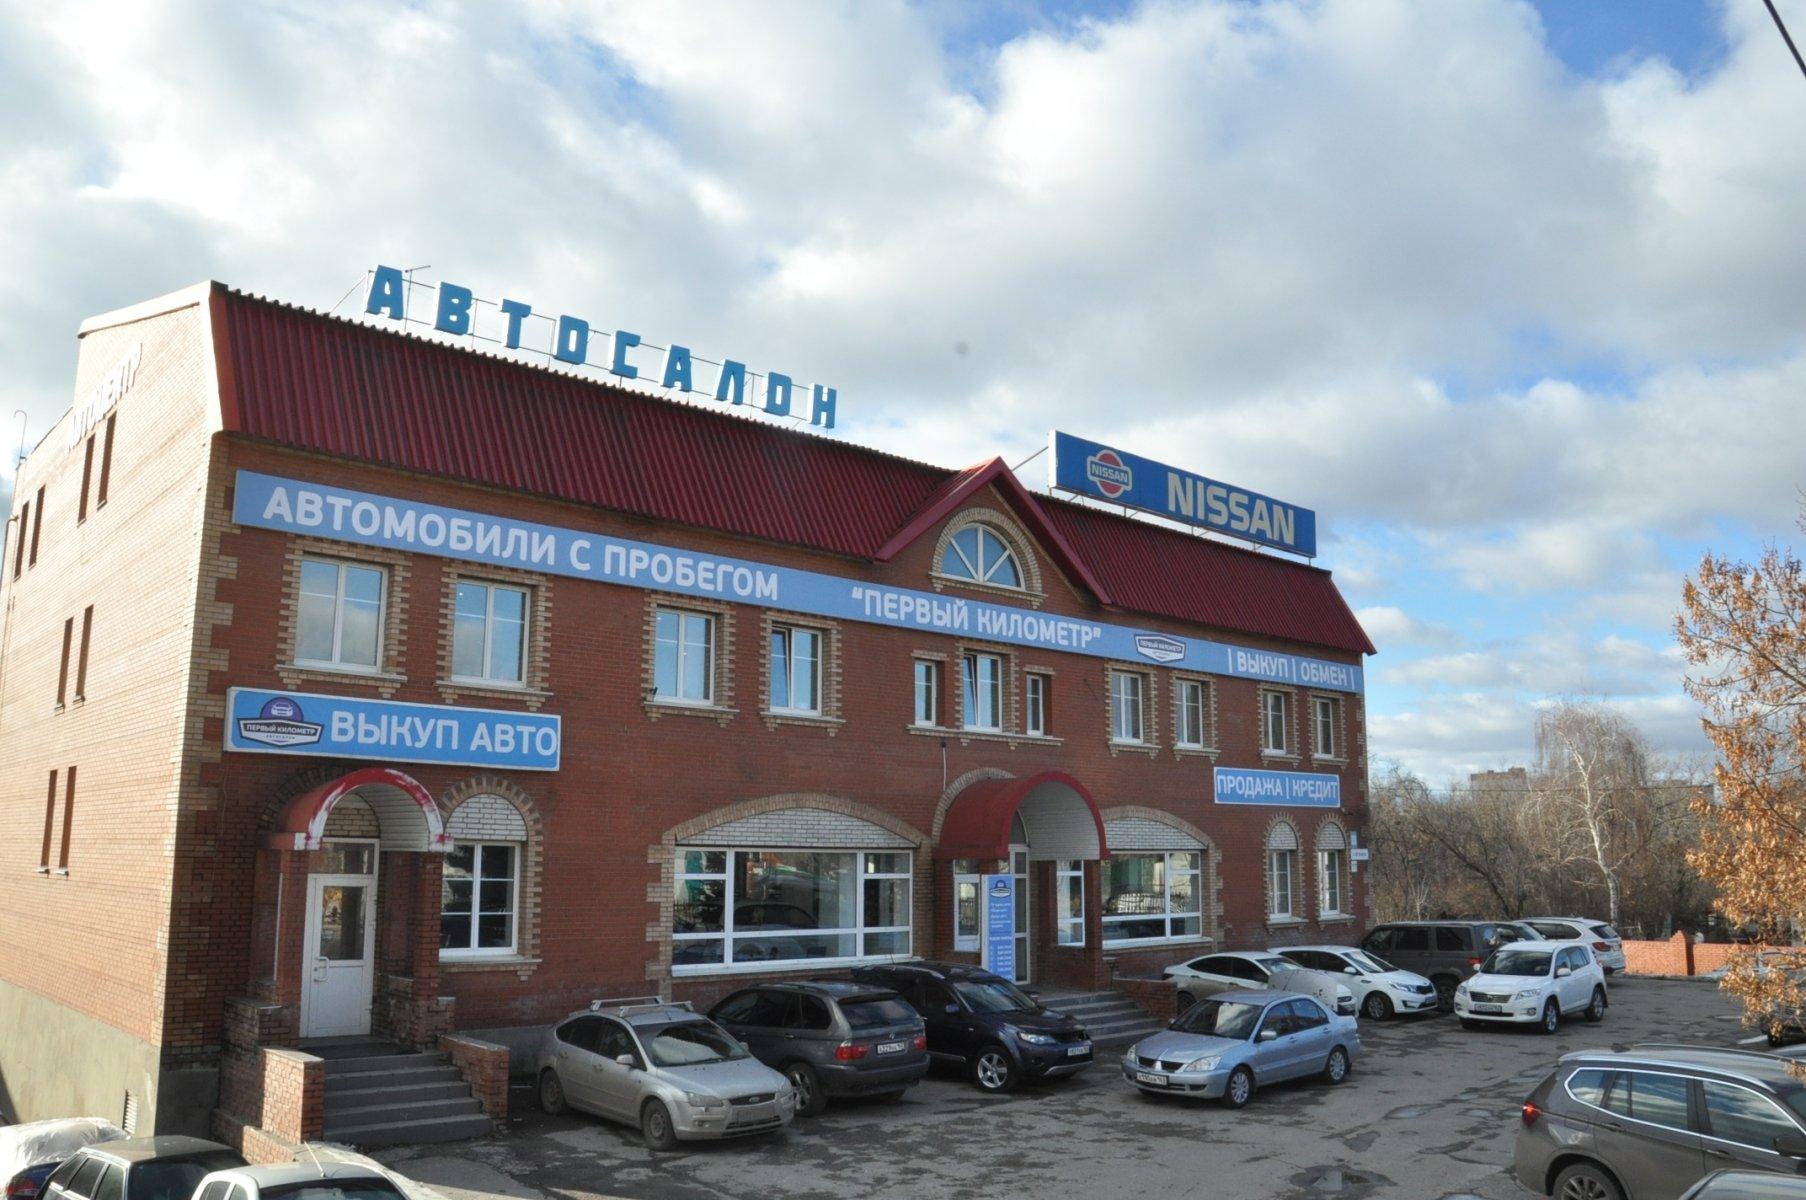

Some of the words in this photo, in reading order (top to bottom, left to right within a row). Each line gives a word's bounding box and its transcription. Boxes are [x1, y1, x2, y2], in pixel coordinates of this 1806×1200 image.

[366, 264, 838, 429] АВТОСАЛОН
[1091, 463, 1128, 483] NISSAN
[1168, 472, 1295, 545] NISSAN
[262, 486, 556, 566] АВТОМОБИЛИ
[569, 541, 592, 571] С
[604, 545, 779, 600] ПРОБЕГОМ
[1238, 654, 1288, 679] ВЫКУП
[1300, 664, 1346, 685] ОБМЕН
[247, 724, 276, 732] ПЕРВЫЙ
[277, 727, 315, 735] КИЛОМЕТР
[332, 711, 458, 750] ВЫКУП
[470, 721, 557, 757] АВТО
[1217, 774, 1282, 797] ПРОДАЖА
[1292, 780, 1338, 801] КРЕДИТ
